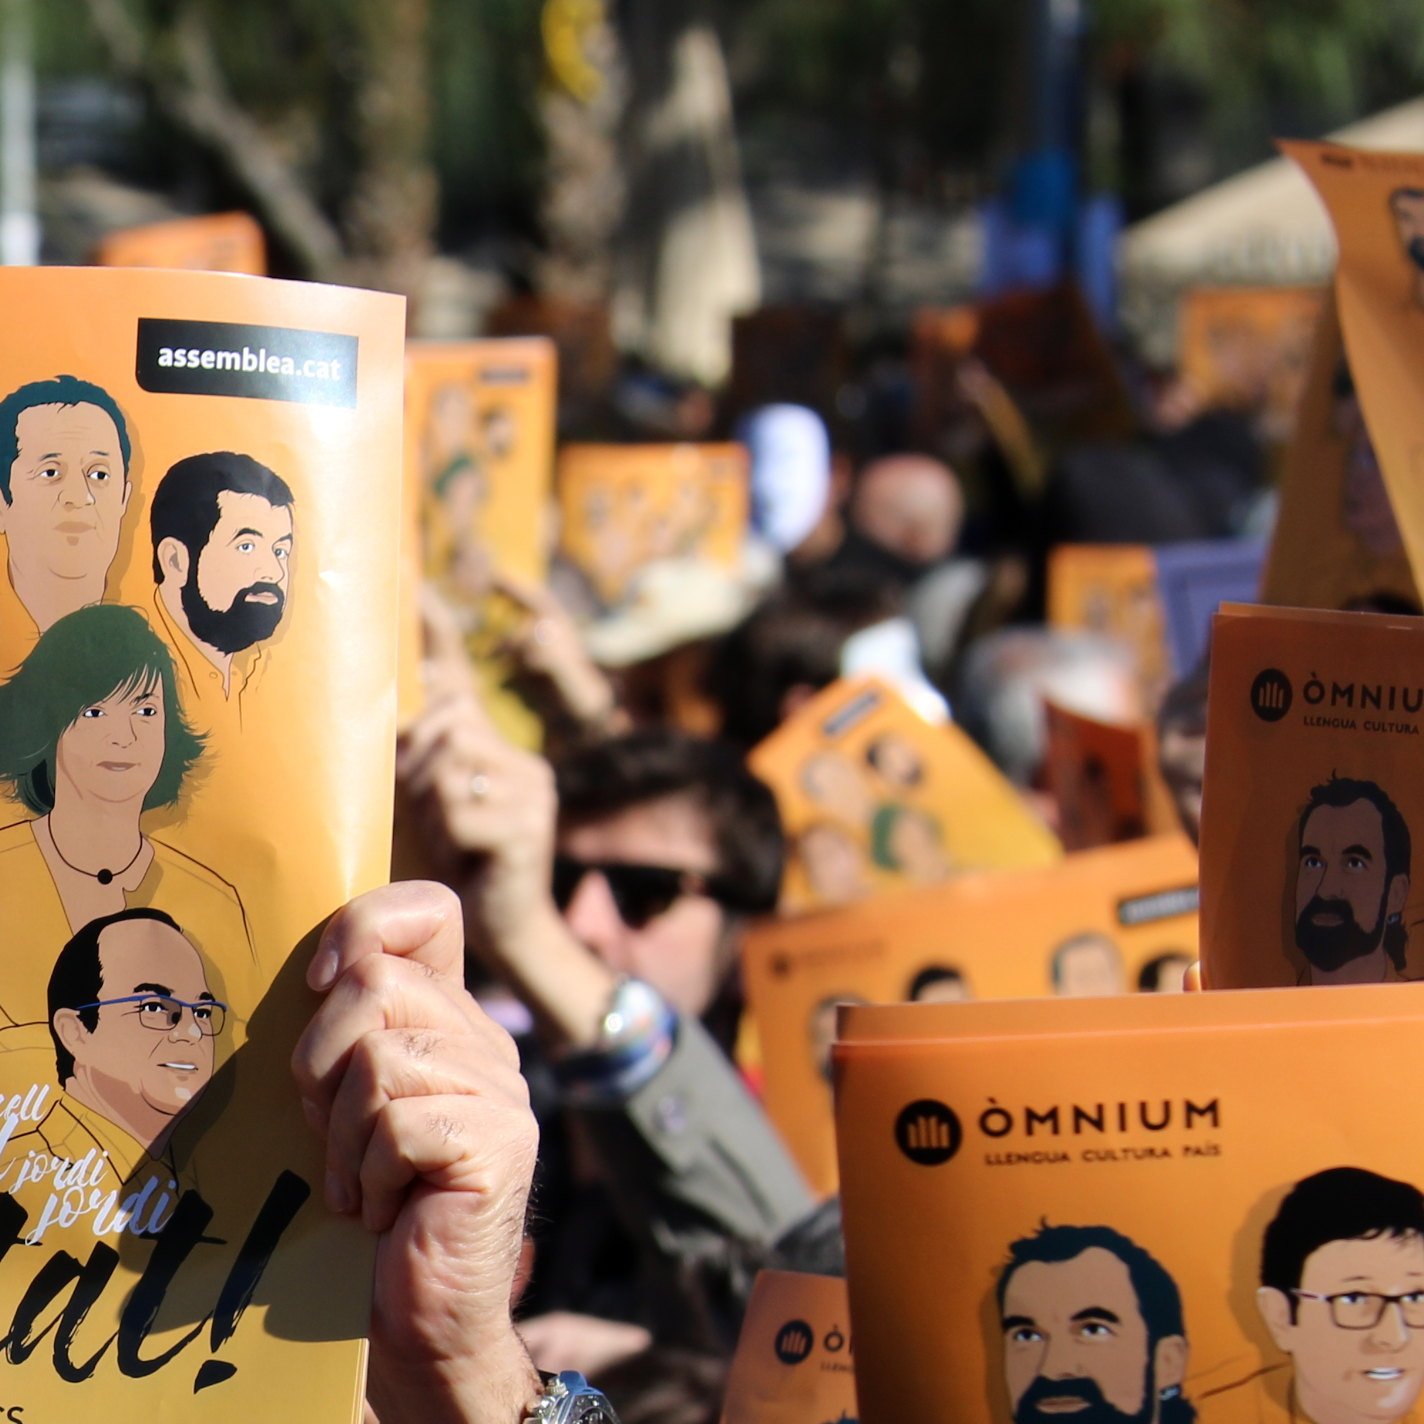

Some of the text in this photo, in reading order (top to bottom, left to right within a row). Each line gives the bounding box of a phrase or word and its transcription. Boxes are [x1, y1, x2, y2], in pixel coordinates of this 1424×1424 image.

[158, 346, 341, 380] assemblea.cat
[1304, 716, 1419, 735] LLENGUA CULTURA
[979, 1098, 1221, 1138] ÒMNIUM
[8, 1148, 108, 1194] jordi
[985, 1147, 1070, 1166] LLENGUA
[1082, 1146, 1170, 1164] CULTURA
[24, 1174, 178, 1247] jordi
